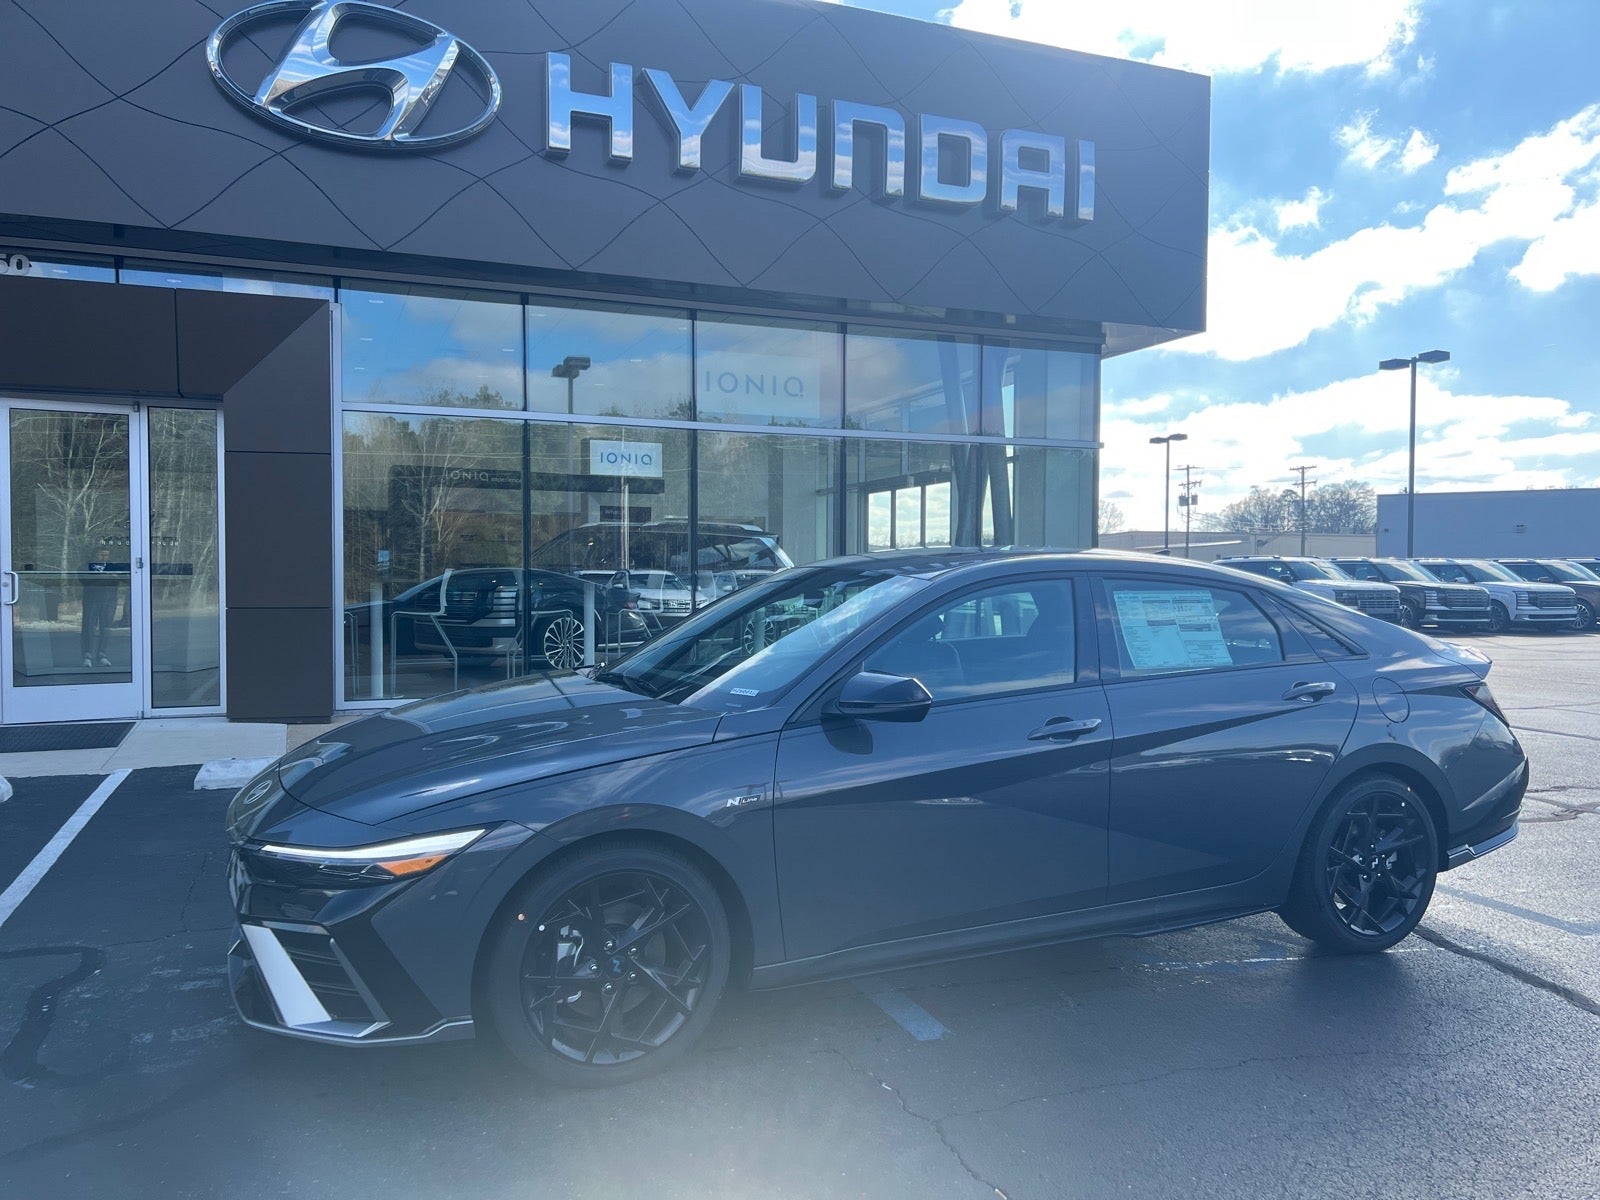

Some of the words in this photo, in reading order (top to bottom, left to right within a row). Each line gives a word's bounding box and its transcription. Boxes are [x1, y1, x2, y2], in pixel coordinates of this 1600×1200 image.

[545, 51, 1096, 222] HYUNDAI
[705, 370, 804, 397] IONIQ
[600, 452, 652, 466] IONIQ
